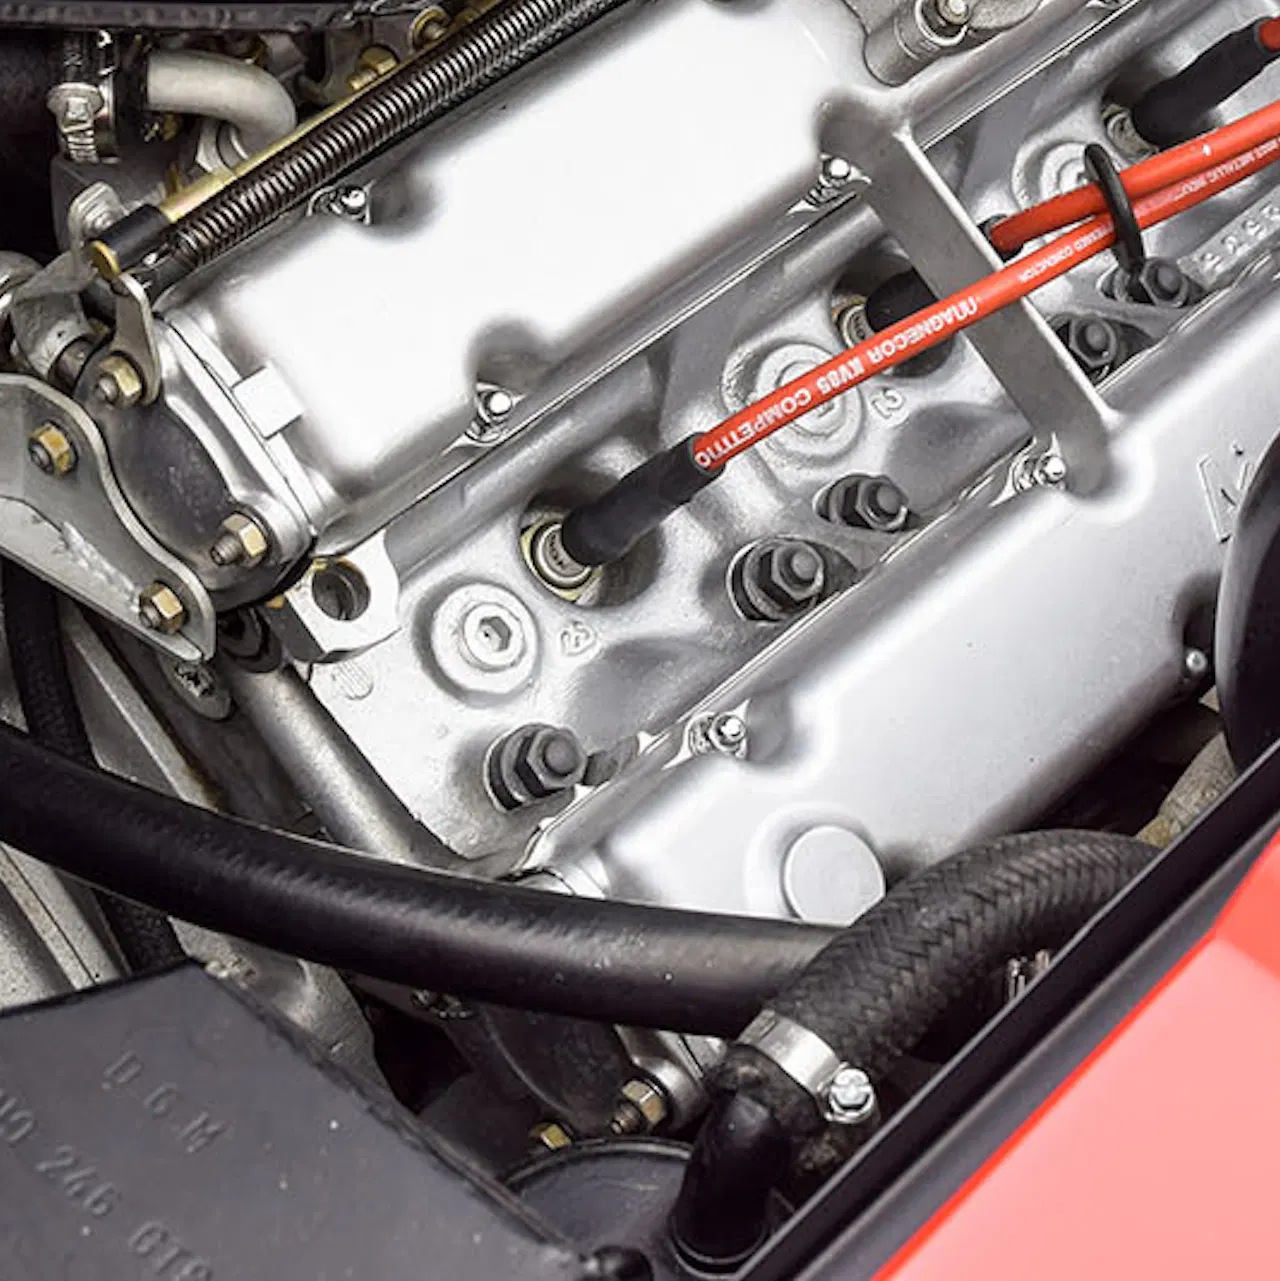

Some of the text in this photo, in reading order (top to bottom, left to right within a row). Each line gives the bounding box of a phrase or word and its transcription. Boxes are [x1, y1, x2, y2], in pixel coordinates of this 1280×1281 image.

[869, 296, 978, 365] MAGNECOR
[817, 357, 865, 395] KV85
[694, 389, 811, 468] COMPETITIO
[34, 1143, 116, 1217] 246
